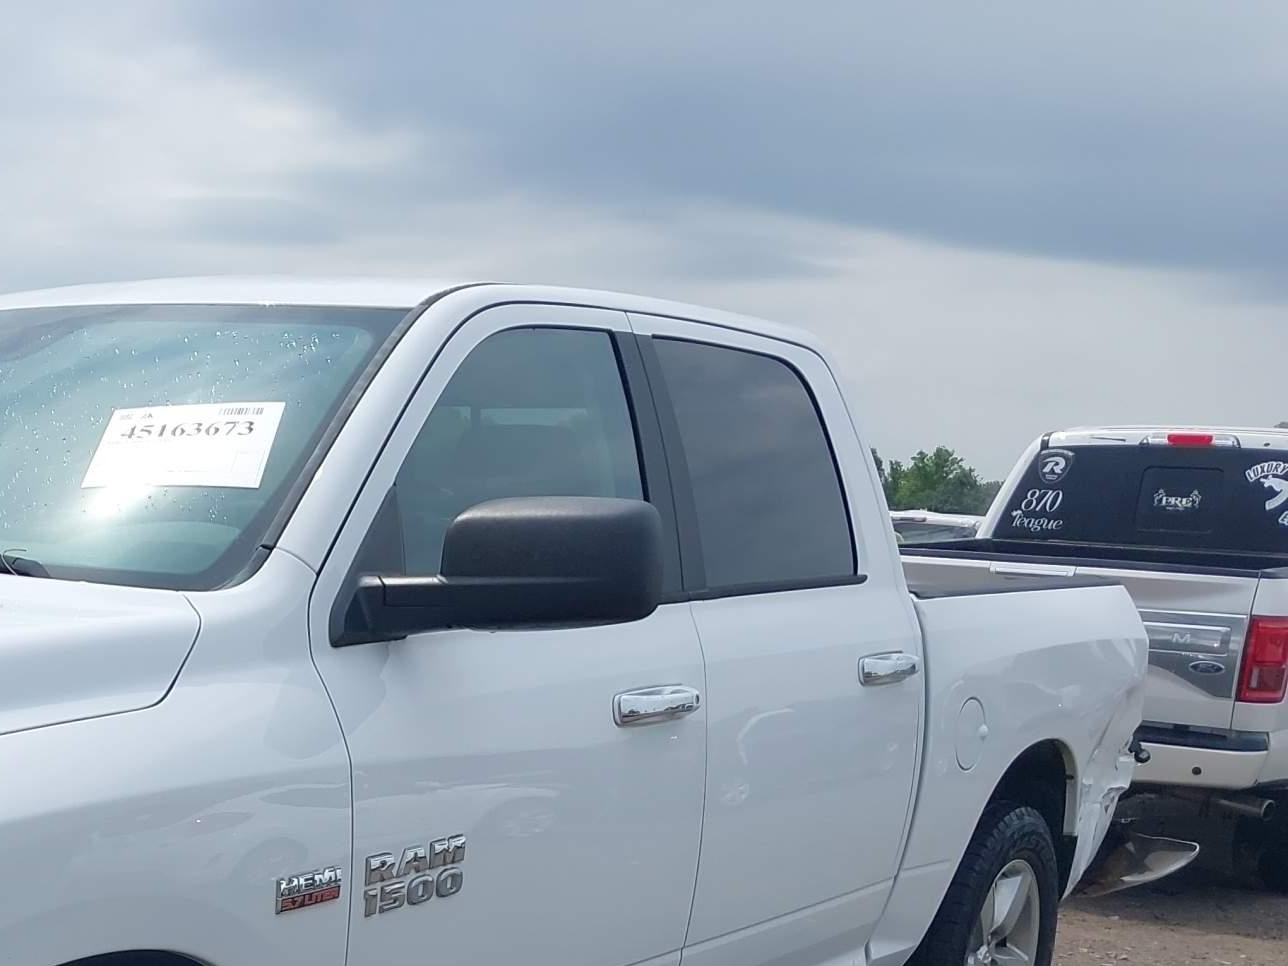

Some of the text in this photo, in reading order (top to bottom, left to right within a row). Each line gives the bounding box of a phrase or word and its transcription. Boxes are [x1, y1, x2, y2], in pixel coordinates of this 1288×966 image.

[120, 420, 255, 439] 45163673
[1245, 461, 1288, 482] LUXURY
[1021, 488, 1063, 512] 870
[1010, 509, 1063, 532] Teague
[364, 833, 467, 887] RAM
[277, 866, 344, 898] HEMI
[363, 866, 464, 918] 1500
